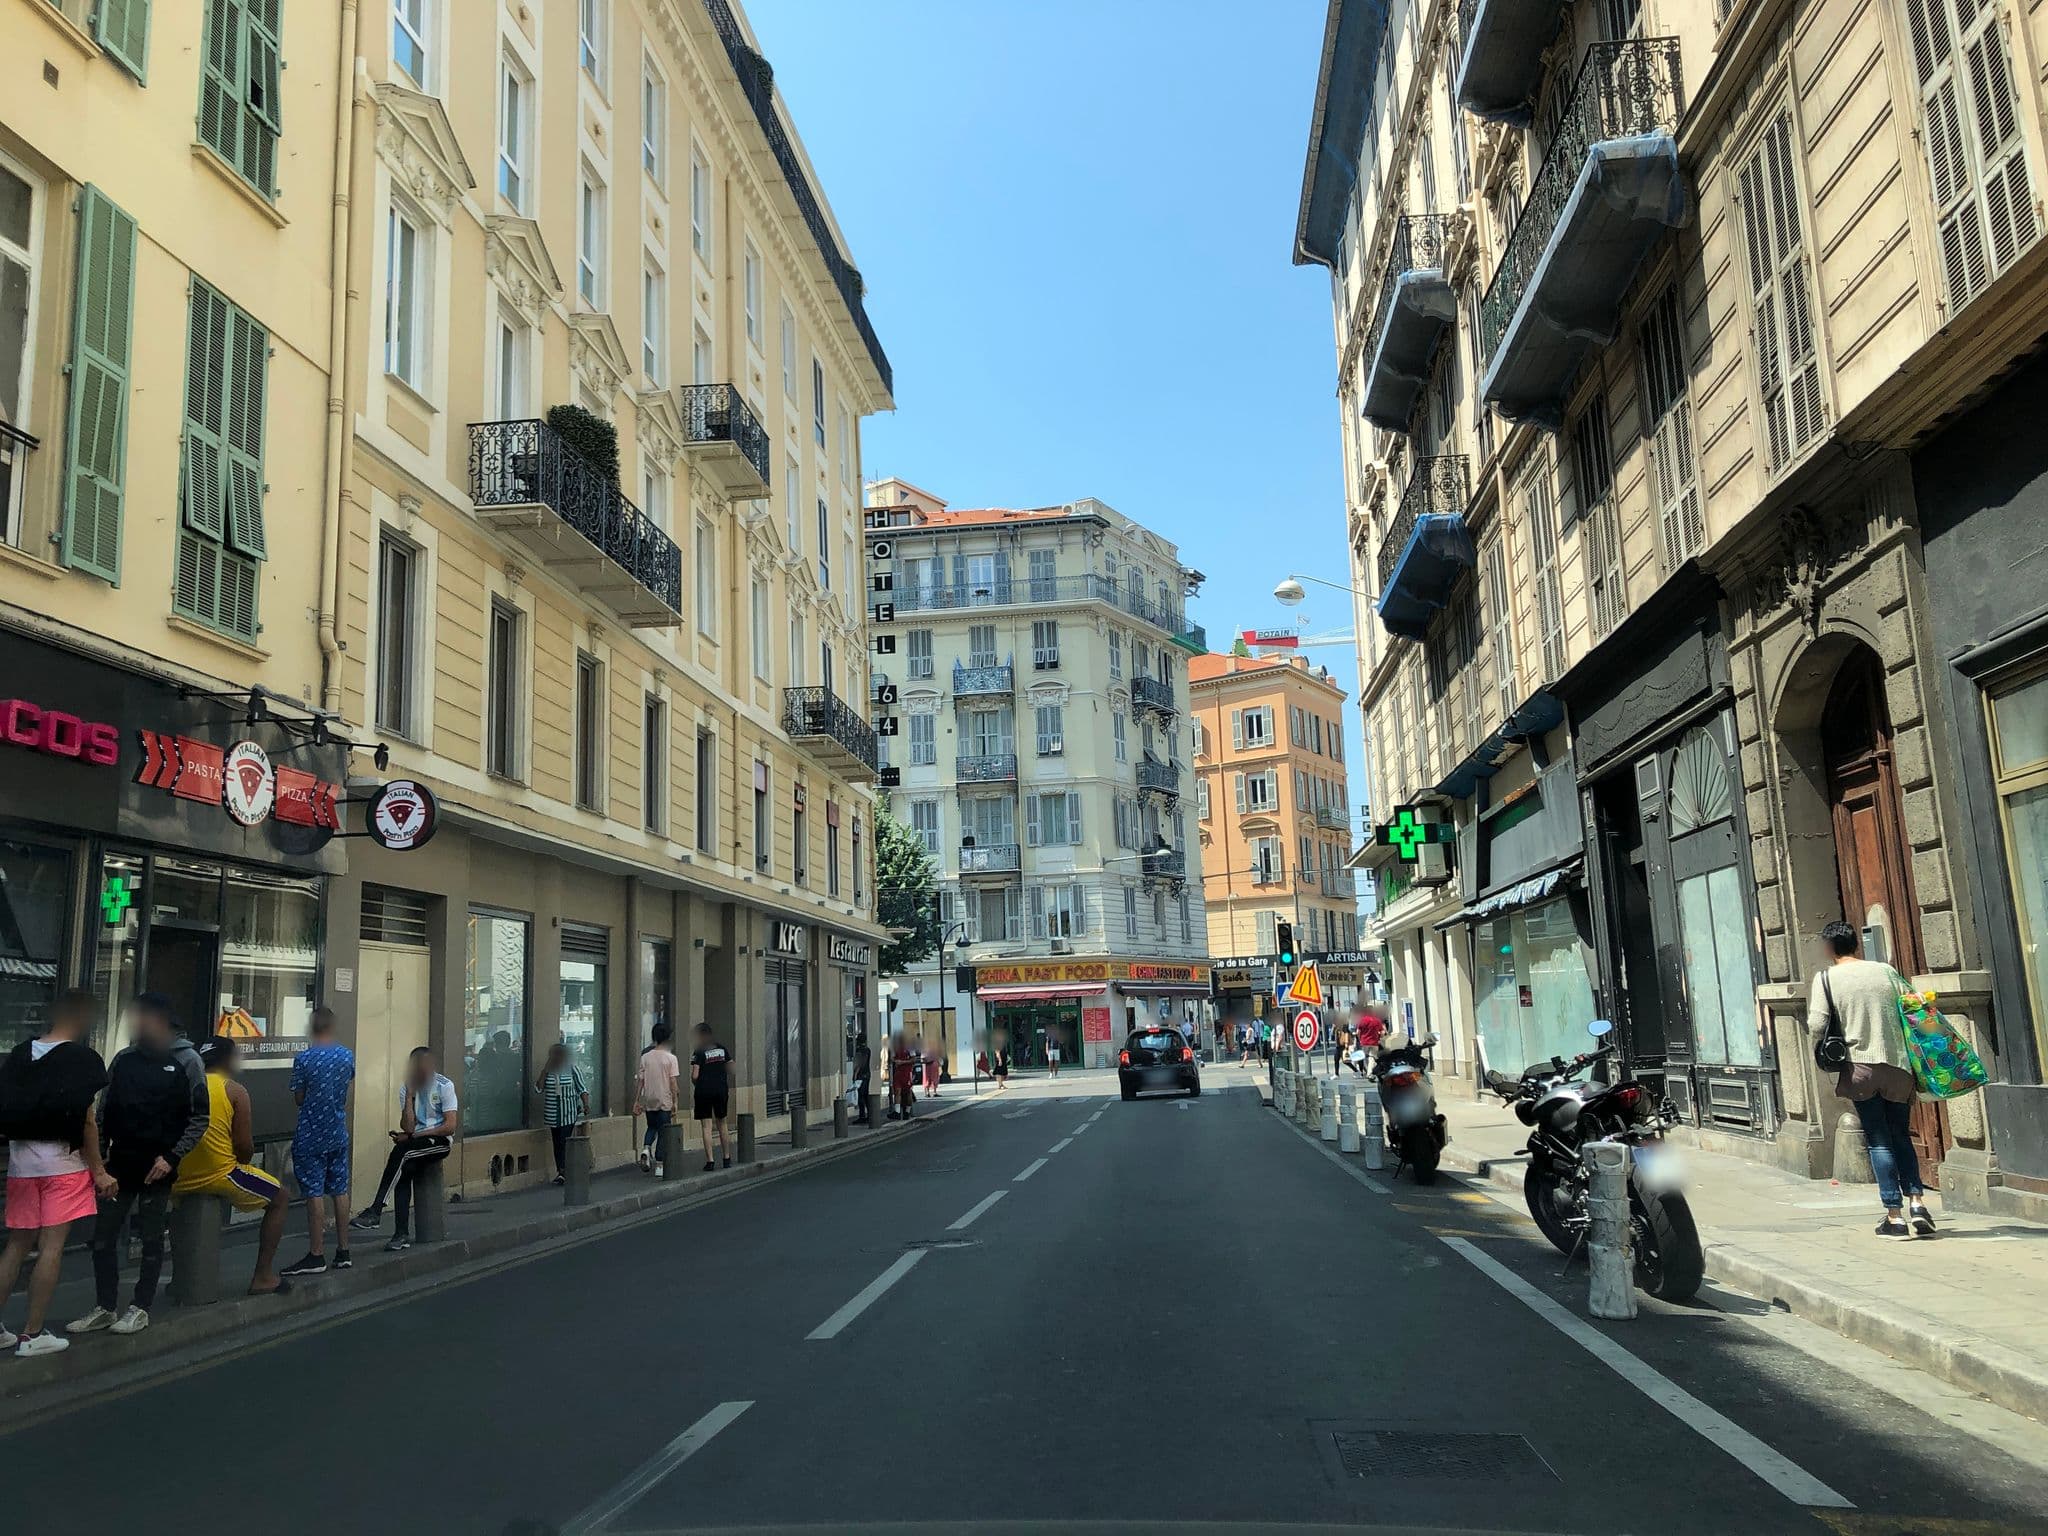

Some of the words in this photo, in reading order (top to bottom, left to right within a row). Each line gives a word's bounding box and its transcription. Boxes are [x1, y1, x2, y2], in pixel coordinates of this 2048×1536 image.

[874, 510, 891, 653] HOTEL
[1258, 629, 1290, 638] POTAIN
[238, 743, 266, 763] ITALIAN
[187, 761, 221, 780] PASTA
[281, 786, 308, 803] PIZZA
[387, 790, 415, 800] ITALIAN
[250, 805, 268, 823] Pizza
[779, 922, 802, 953] KFC
[1226, 958, 1237, 968] de
[1238, 959, 1247, 967] la
[1326, 952, 1368, 963] ARTISAN
[978, 968, 1021, 982] CHINA
[1024, 966, 1060, 981] FAST
[1065, 965, 1106, 980] FOOD
[1299, 1023, 1312, 1039] 30
[259, 1043, 290, 1053] RESTAURANT
